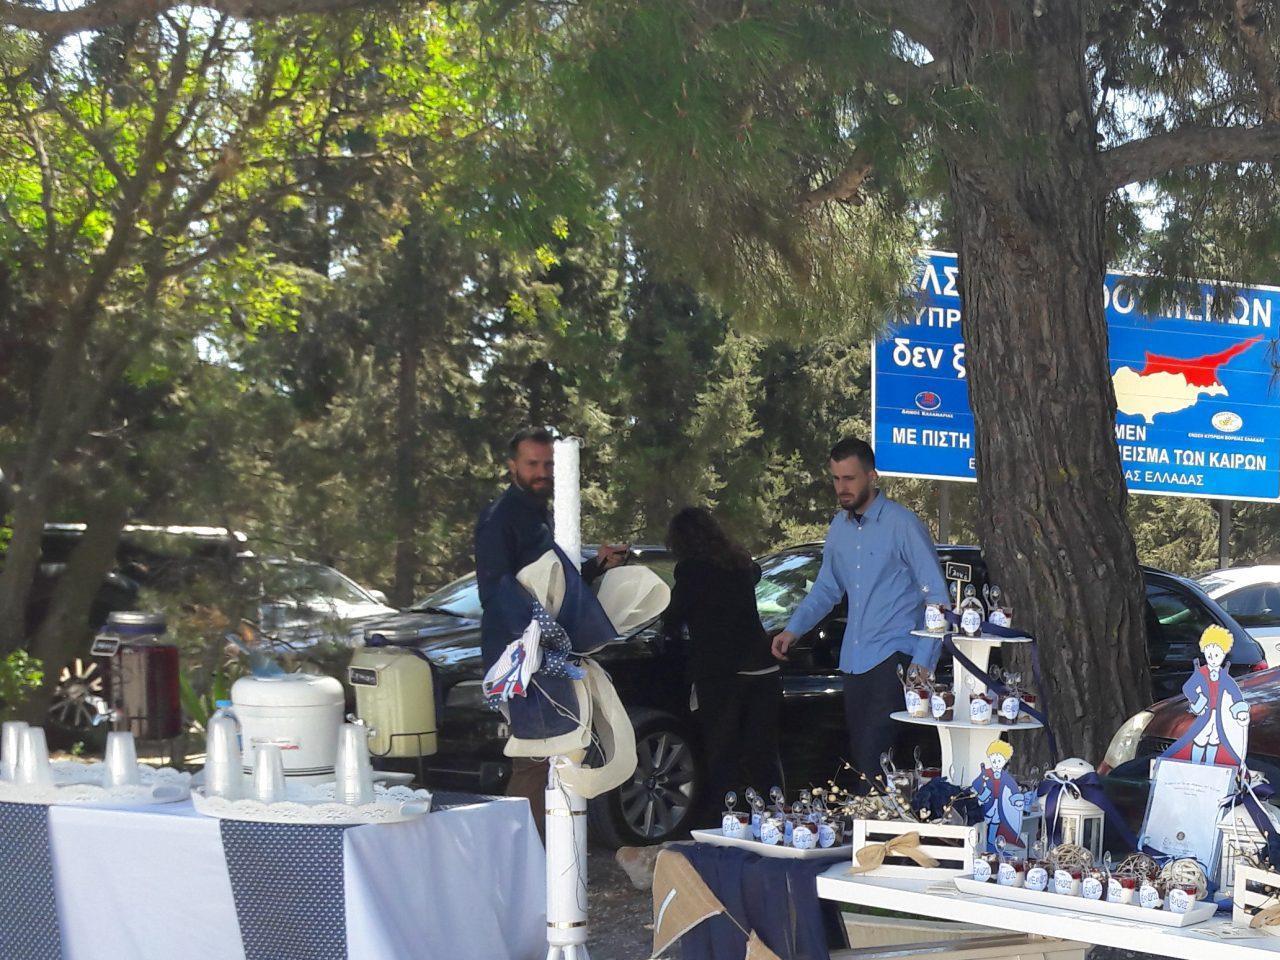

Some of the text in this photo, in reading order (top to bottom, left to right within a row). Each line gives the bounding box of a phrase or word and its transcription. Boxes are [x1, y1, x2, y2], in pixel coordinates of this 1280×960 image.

[893, 337, 944, 370] δεν
[1115, 423, 1147, 442] ΜΕΝ
[892, 427, 1267, 471] ΜΕ ΠΙΣΤΗ ΕΙΣΜΑ ΤΩΝ ΚΑΙΡΩΝ
[1144, 471, 1204, 486] ΕΛΛΑΔΑΣ
